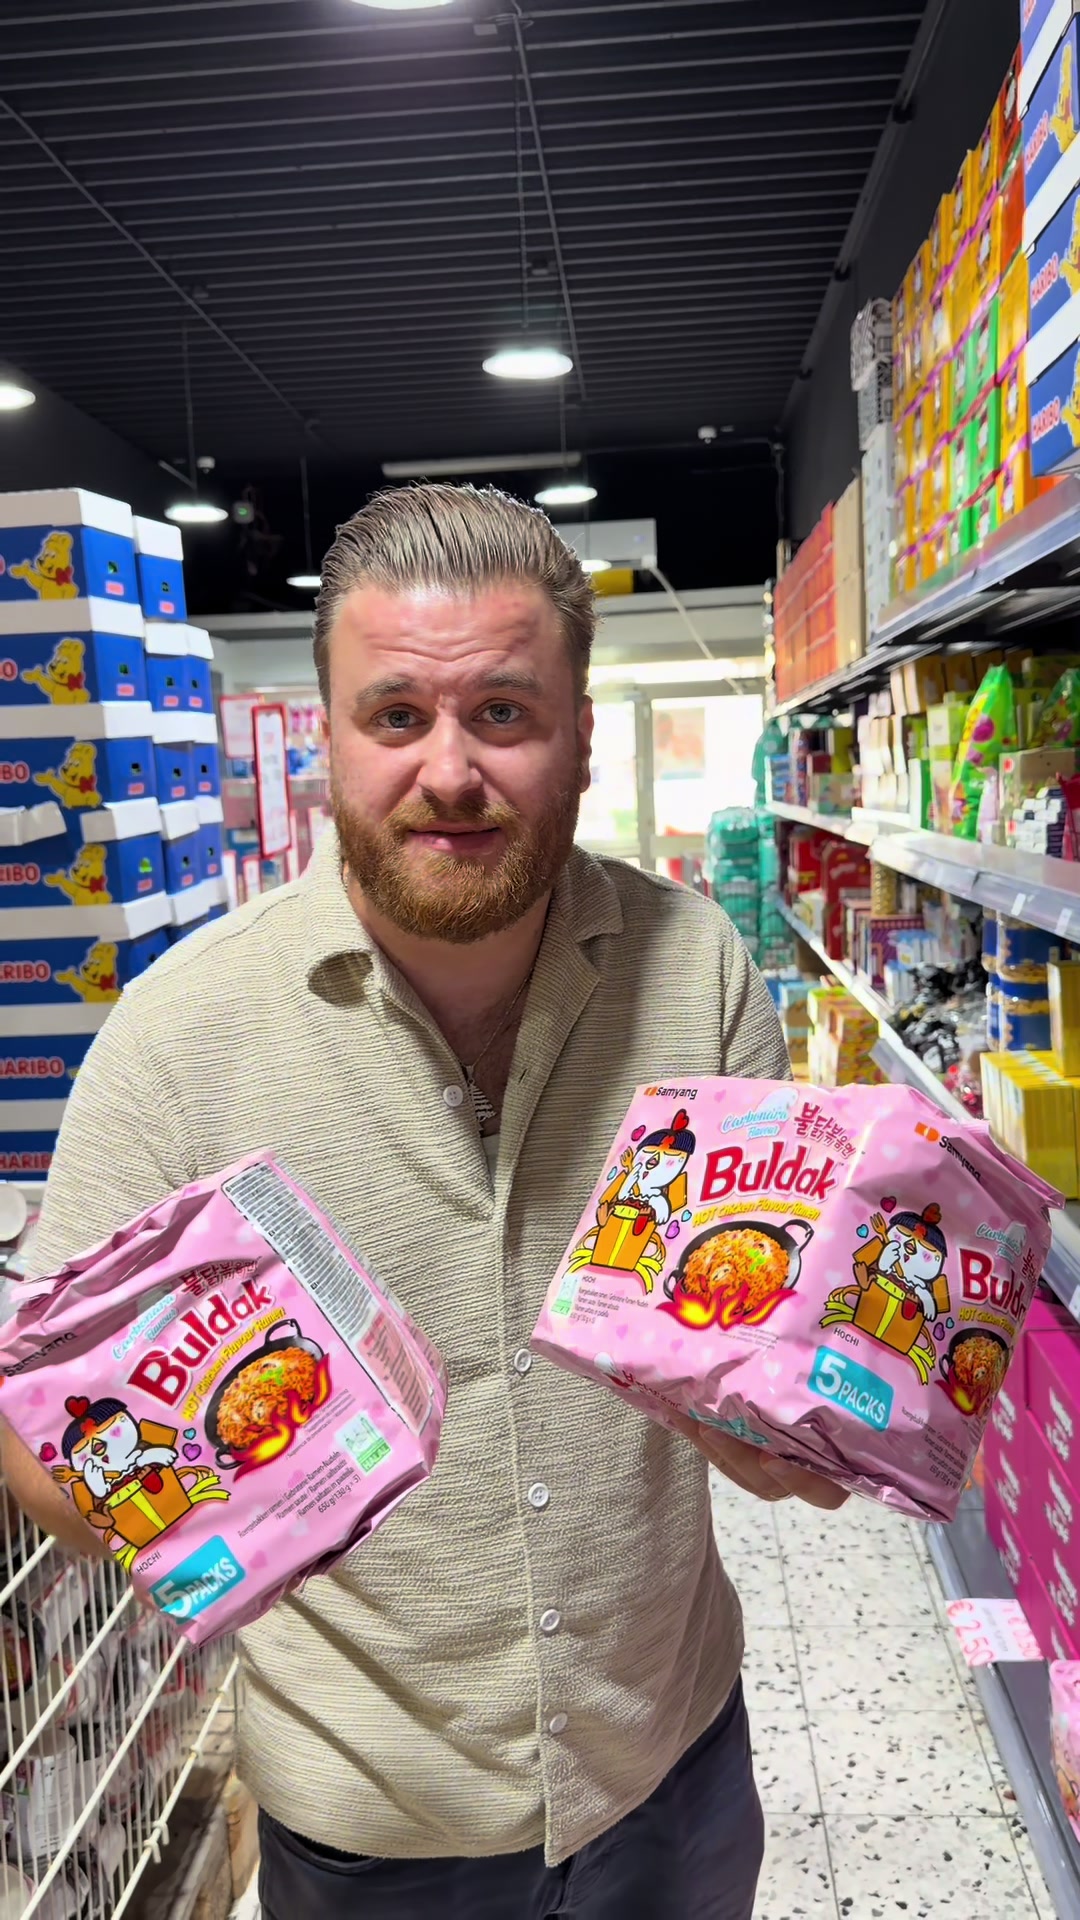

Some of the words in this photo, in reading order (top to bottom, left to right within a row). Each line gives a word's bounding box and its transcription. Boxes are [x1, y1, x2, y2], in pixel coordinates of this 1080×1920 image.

[656, 1086, 698, 1099] Samyang
[722, 1110, 789, 1132] Carbonara
[794, 1102, 856, 1158] 불닭볶음면
[700, 1142, 835, 1201] Buldak
[692, 1207, 718, 1227] HOT
[756, 1198, 791, 1212] Flavour
[791, 1202, 821, 1221] Ramen
[113, 1296, 173, 1359] Carbonara
[833, 1327, 860, 1346] HOCHI
[959, 1308, 976, 1321] HOT
[127, 1279, 273, 1406] Buldak
[182, 1391, 202, 1421] HOT
[221, 1327, 256, 1360] Flavour
[815, 1353, 847, 1396] 5
[838, 1380, 886, 1424] PACKS
[136, 1551, 162, 1574] HOCHI
[185, 1557, 237, 1604] PACKS
